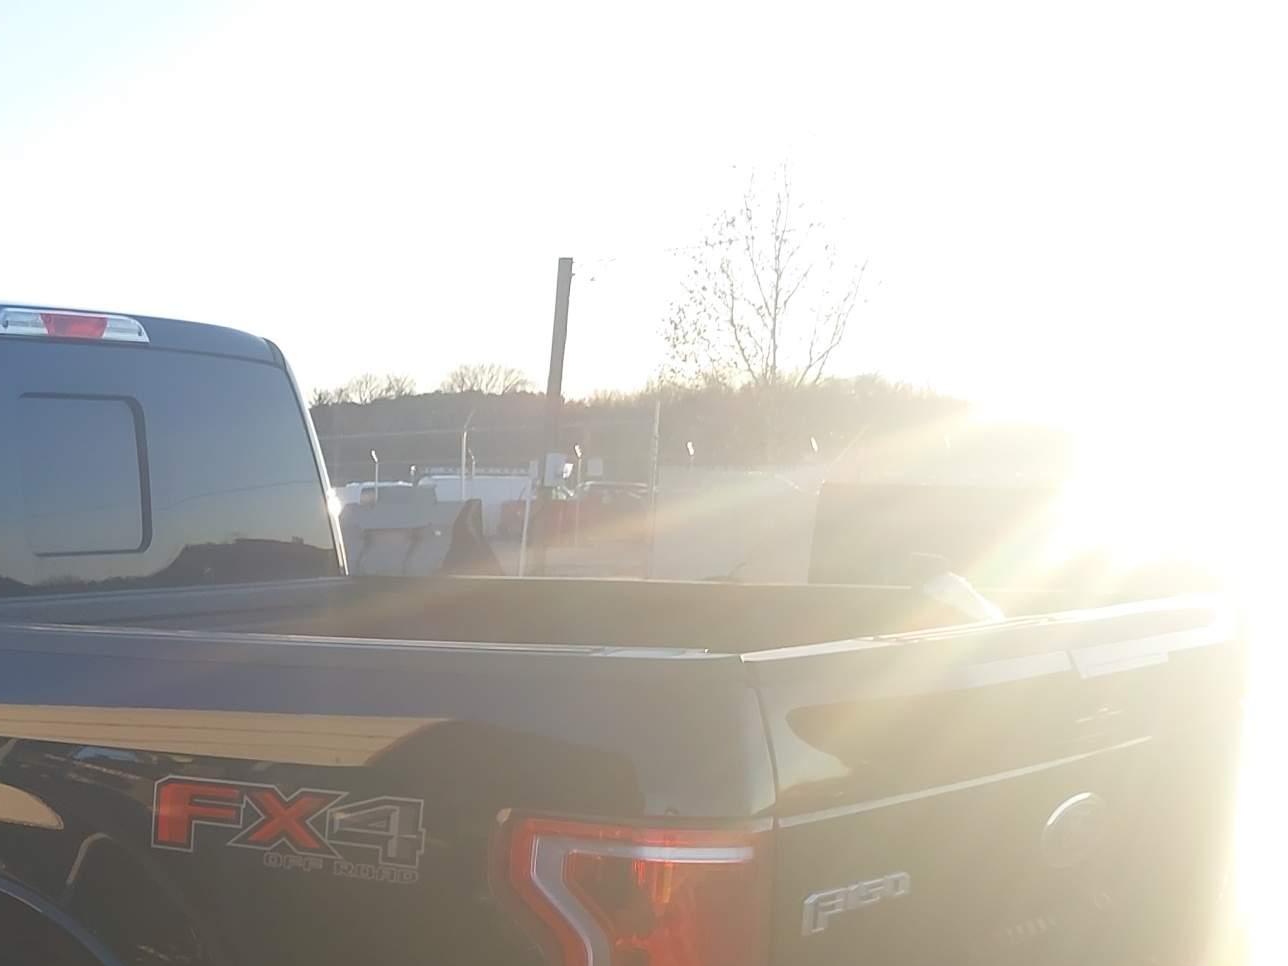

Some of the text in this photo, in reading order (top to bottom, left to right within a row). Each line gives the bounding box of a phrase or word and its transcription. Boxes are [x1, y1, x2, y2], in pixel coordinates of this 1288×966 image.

[151, 773, 426, 870] FX4
[263, 851, 419, 885] OFF ROAD
